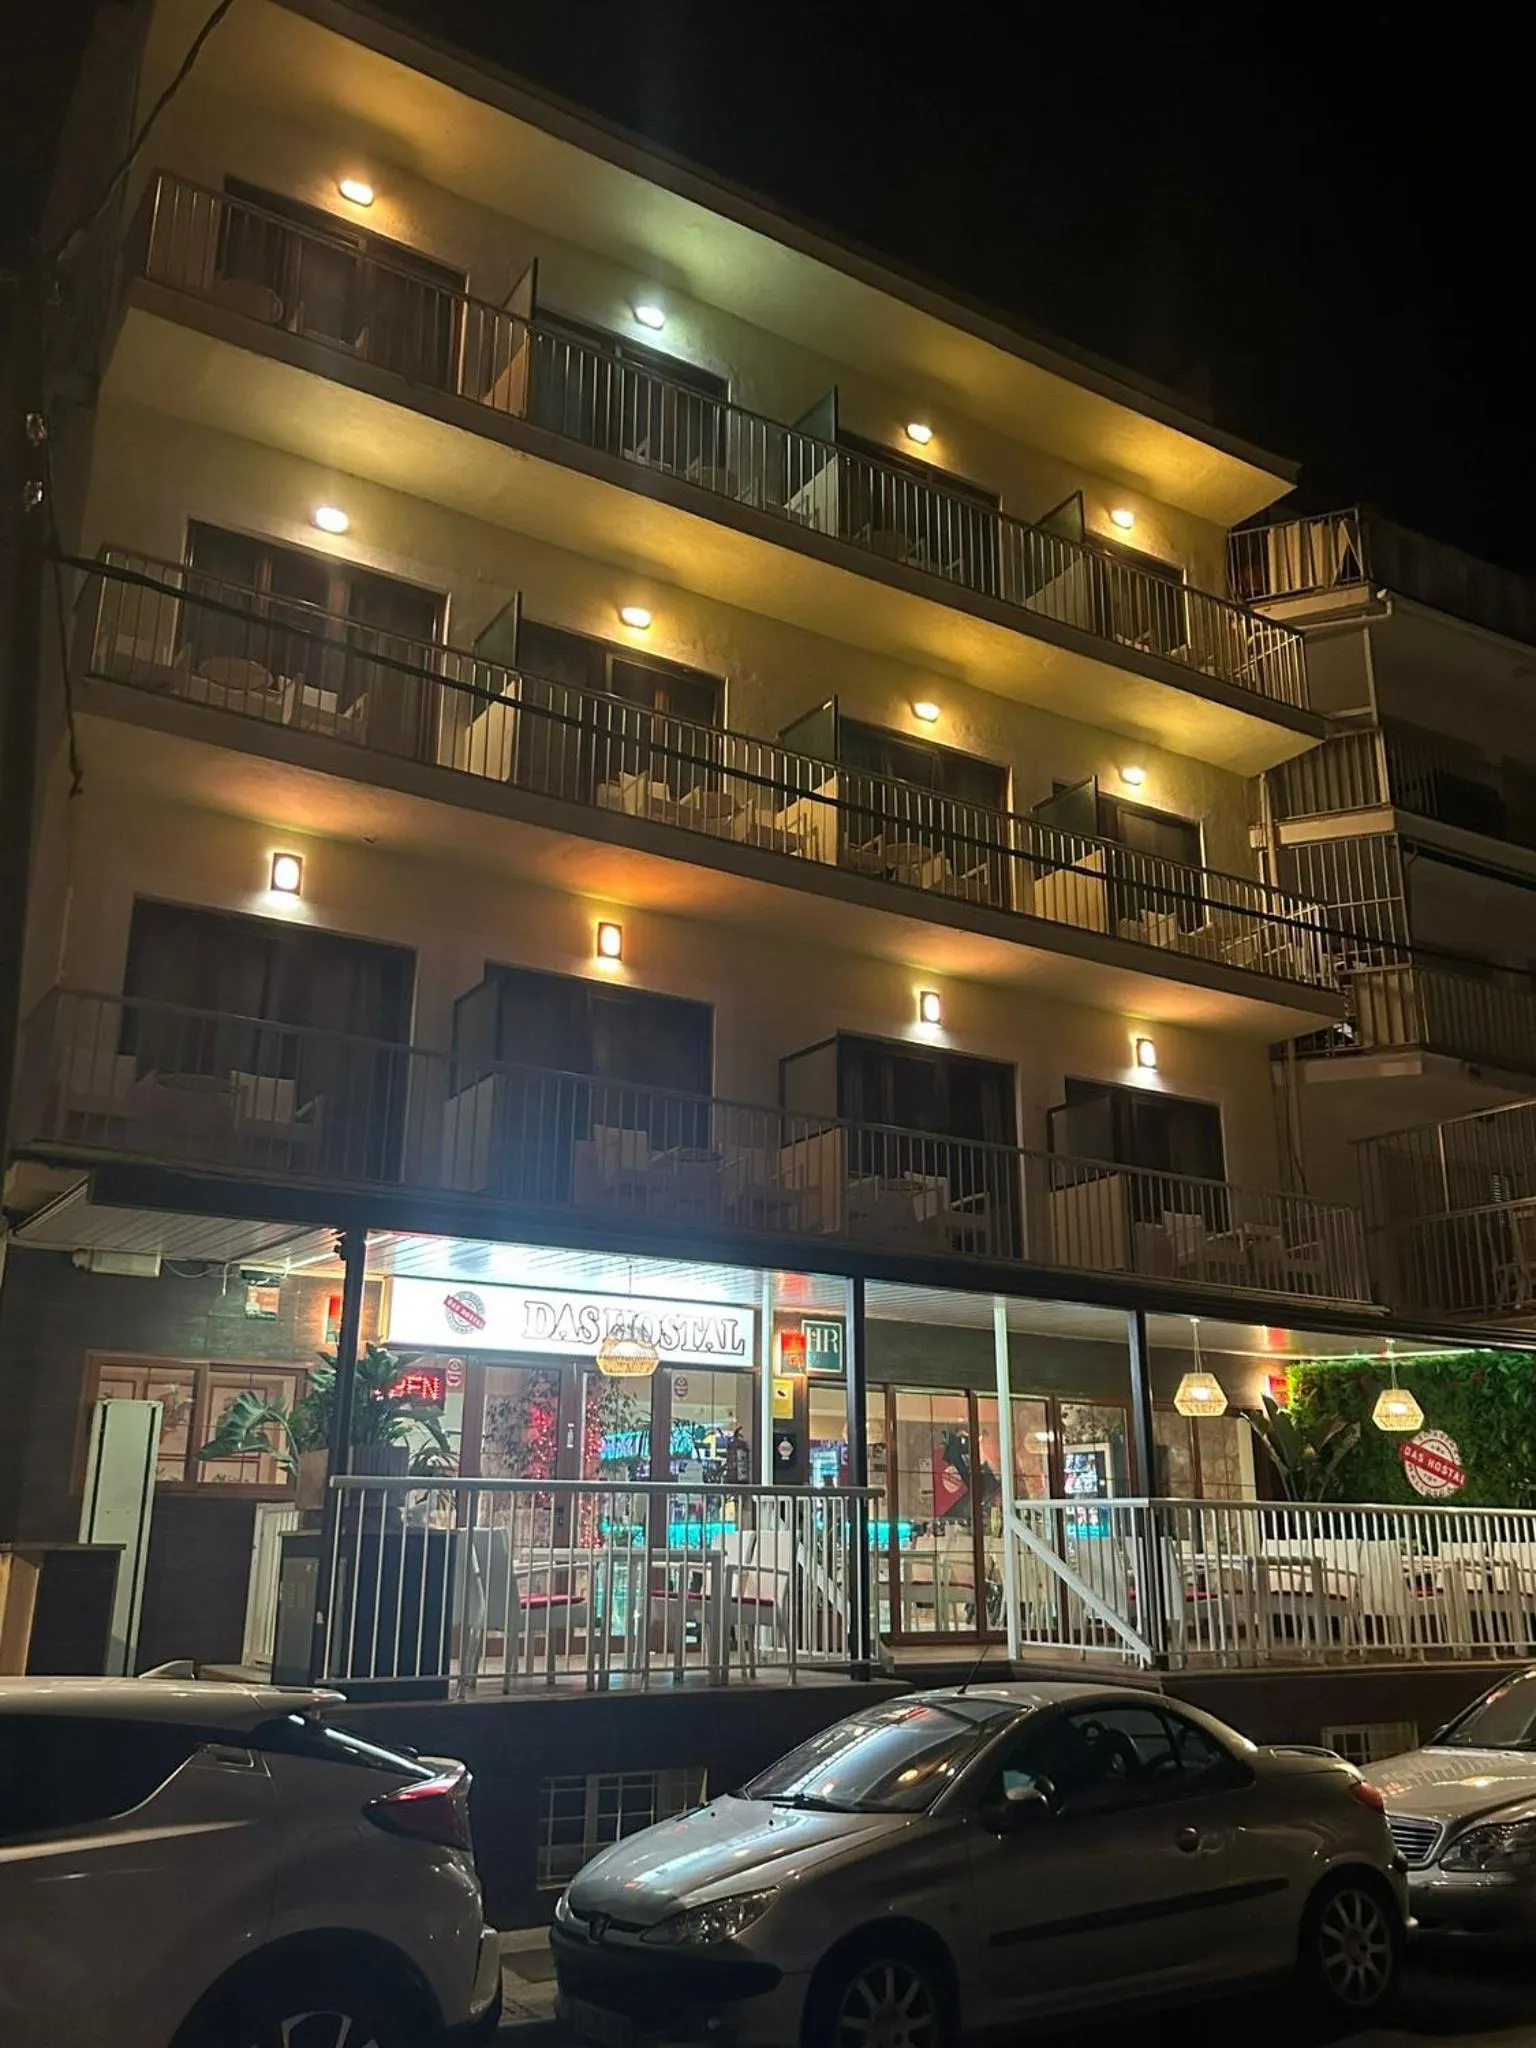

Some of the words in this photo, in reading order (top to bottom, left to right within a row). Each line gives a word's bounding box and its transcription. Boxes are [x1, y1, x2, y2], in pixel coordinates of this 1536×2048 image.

[524, 1301, 601, 1345] DAS
[602, 1307, 745, 1356] HOSTAL
[805, 1326, 839, 1354] HR
[1404, 1446, 1424, 1463] DAS
